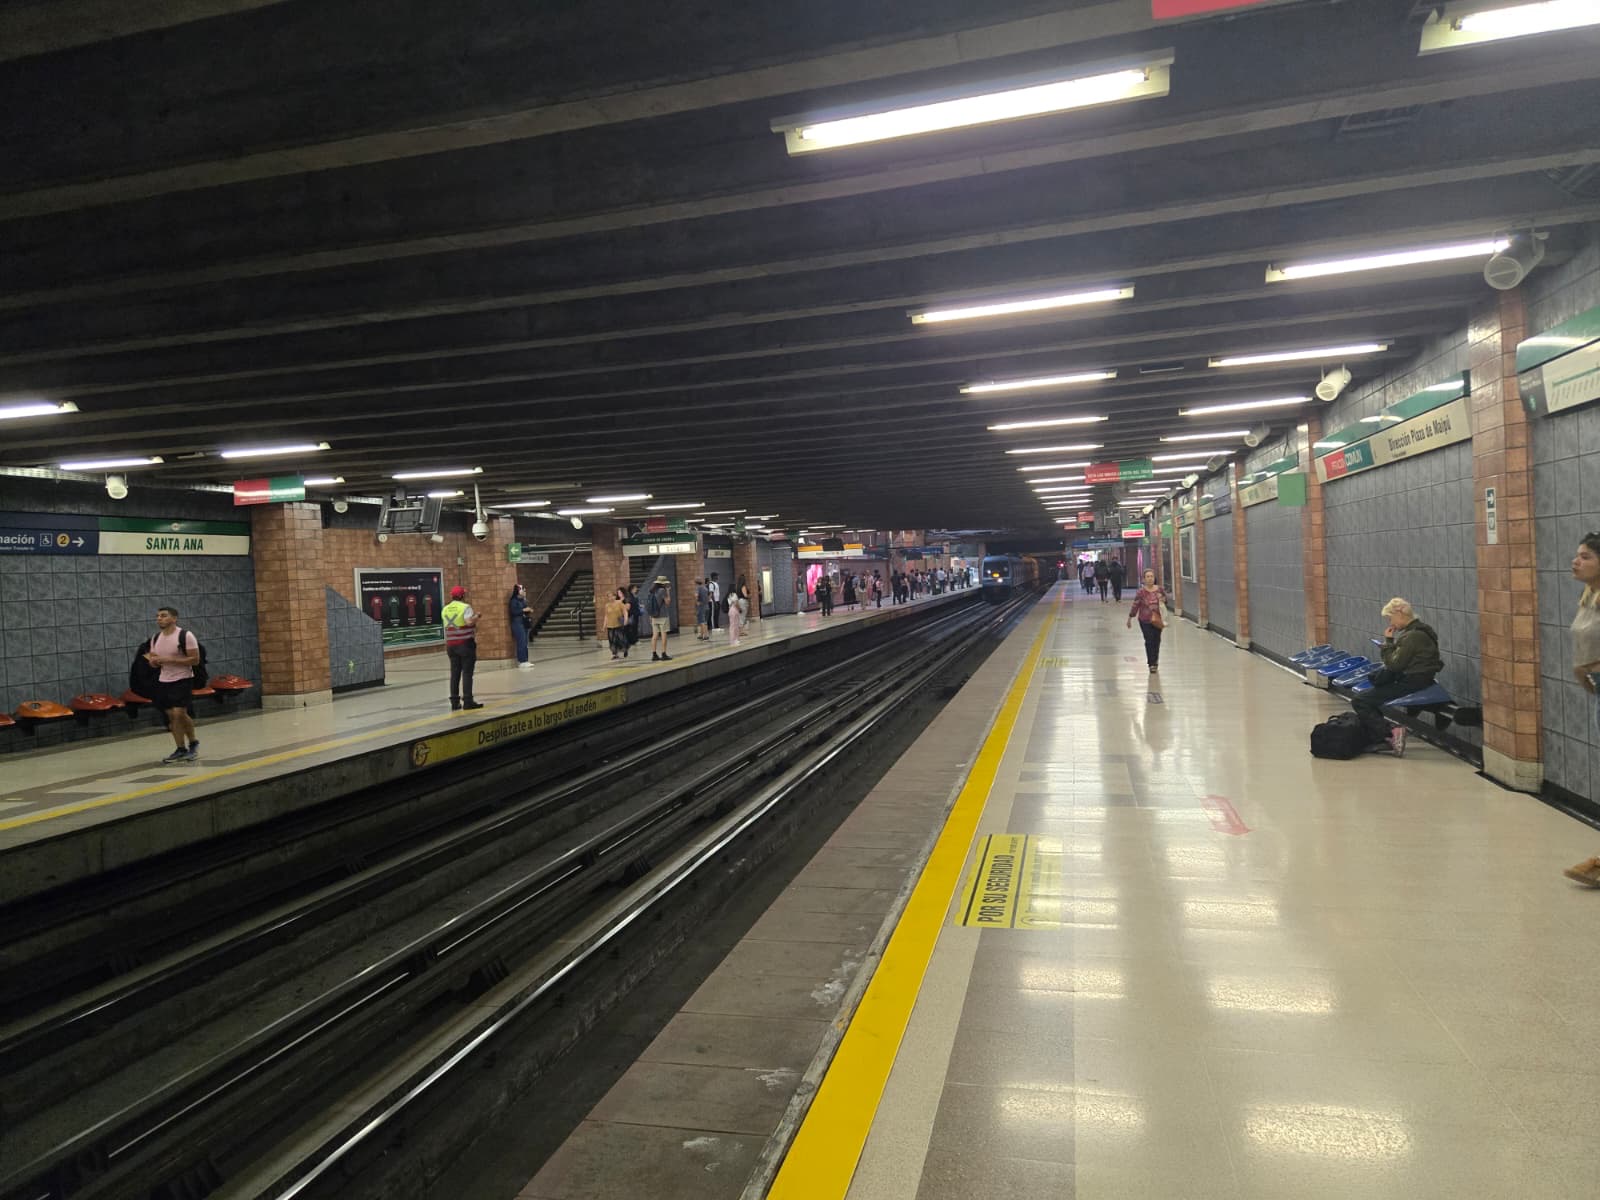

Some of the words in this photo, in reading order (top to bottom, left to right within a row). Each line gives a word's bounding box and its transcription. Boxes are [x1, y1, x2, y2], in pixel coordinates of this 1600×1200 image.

[1410, 428, 1426, 443] Plaza
[1425, 424, 1434, 438] de
[0, 534, 35, 544] ación
[146, 537, 180, 551] SANTA
[183, 538, 204, 551] ANA
[478, 721, 527, 745] Desplázate
[534, 715, 542, 726] lo
[544, 712, 562, 726] largo
[564, 702, 574, 718] del
[575, 699, 597, 714] andén
[986, 855, 1015, 892] SEGURIDAD
[982, 894, 1007, 904] SU
[977, 905, 1005, 923] POR
